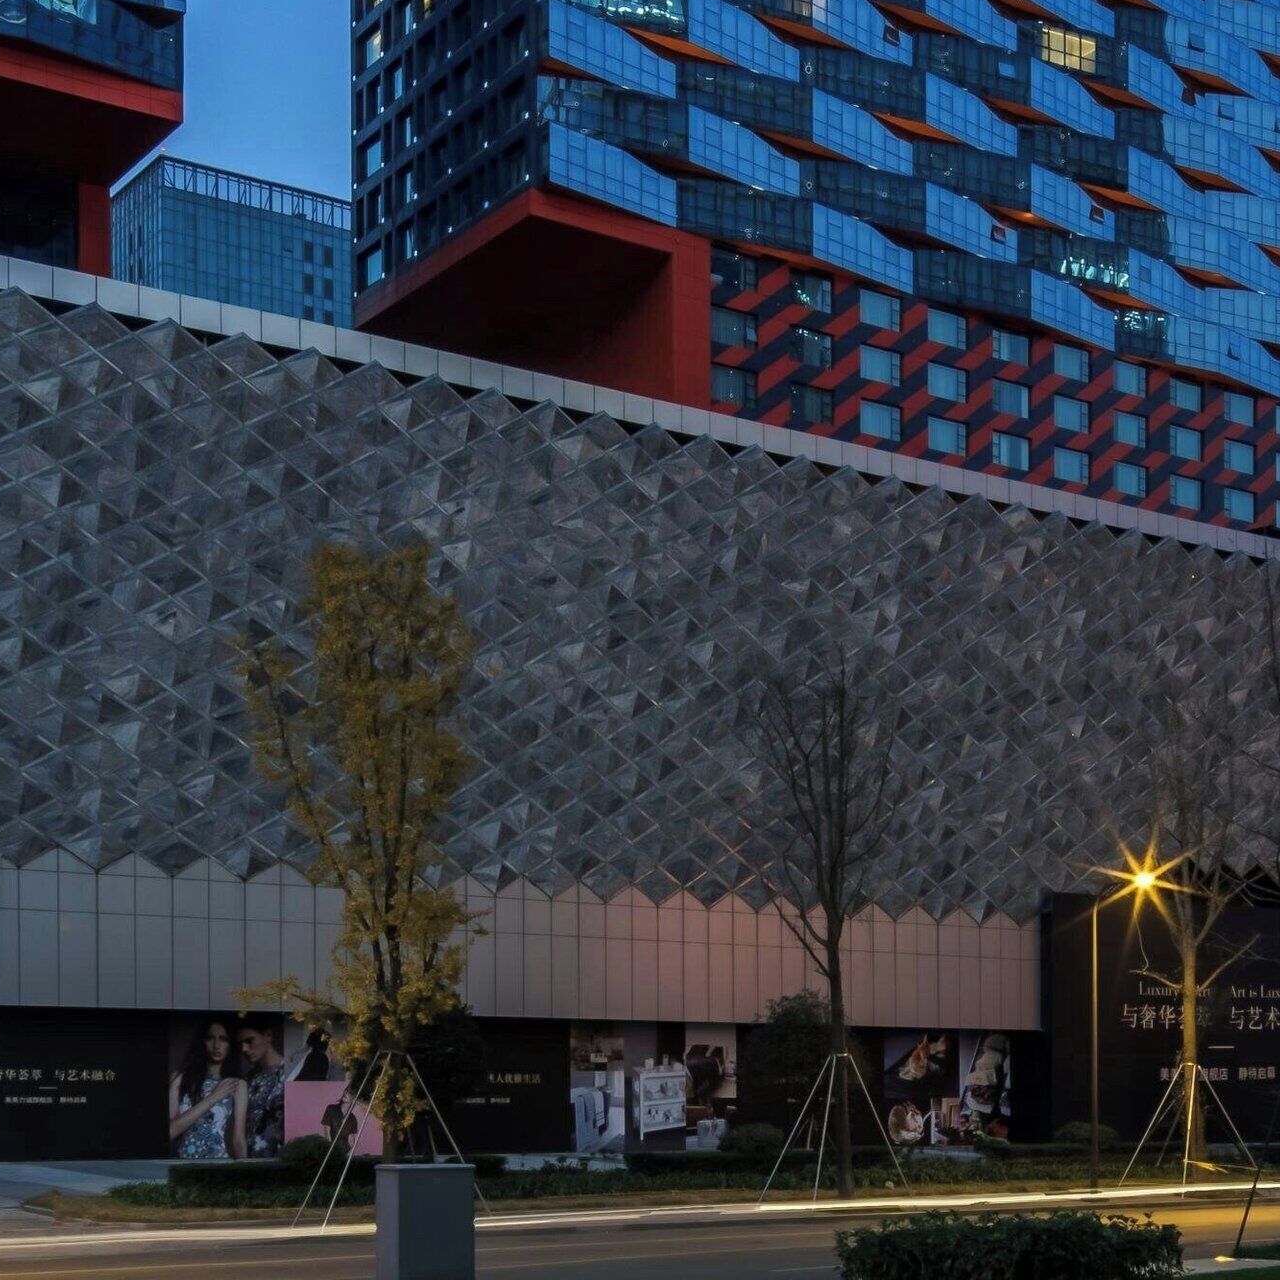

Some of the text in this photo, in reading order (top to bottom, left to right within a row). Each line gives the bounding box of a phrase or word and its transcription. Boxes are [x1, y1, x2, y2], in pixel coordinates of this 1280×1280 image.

[1248, 985, 1257, 999] is
[54, 1067, 118, 1082] 与艺术融合
